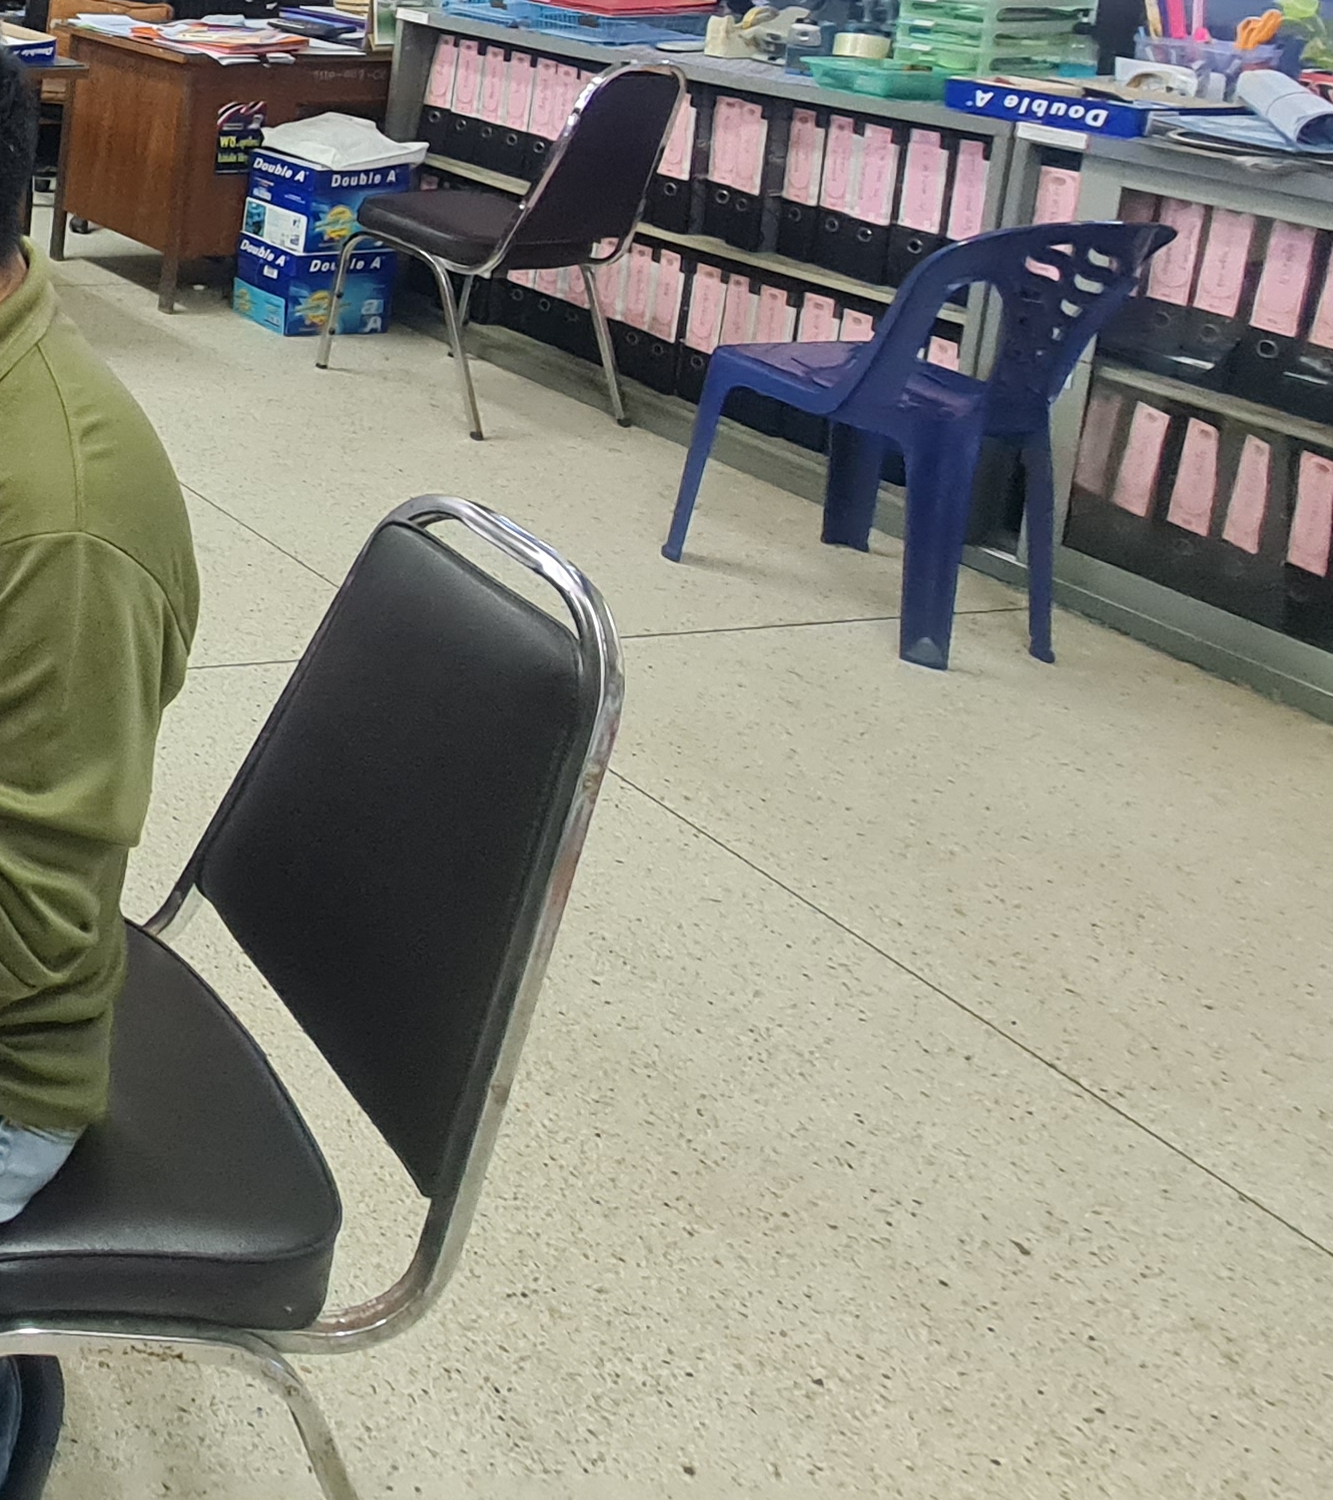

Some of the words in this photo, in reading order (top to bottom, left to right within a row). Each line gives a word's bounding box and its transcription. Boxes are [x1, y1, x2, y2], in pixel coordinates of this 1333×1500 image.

[974, 89, 994, 108] A
[1003, 94, 1109, 128] Double
[253, 157, 293, 179] Double
[294, 169, 305, 183] A
[331, 170, 382, 188] Double
[386, 169, 396, 183] A
[239, 239, 275, 262] Double
[275, 254, 286, 267] A
[309, 257, 364, 273] Doule
[370, 256, 381, 269] A
